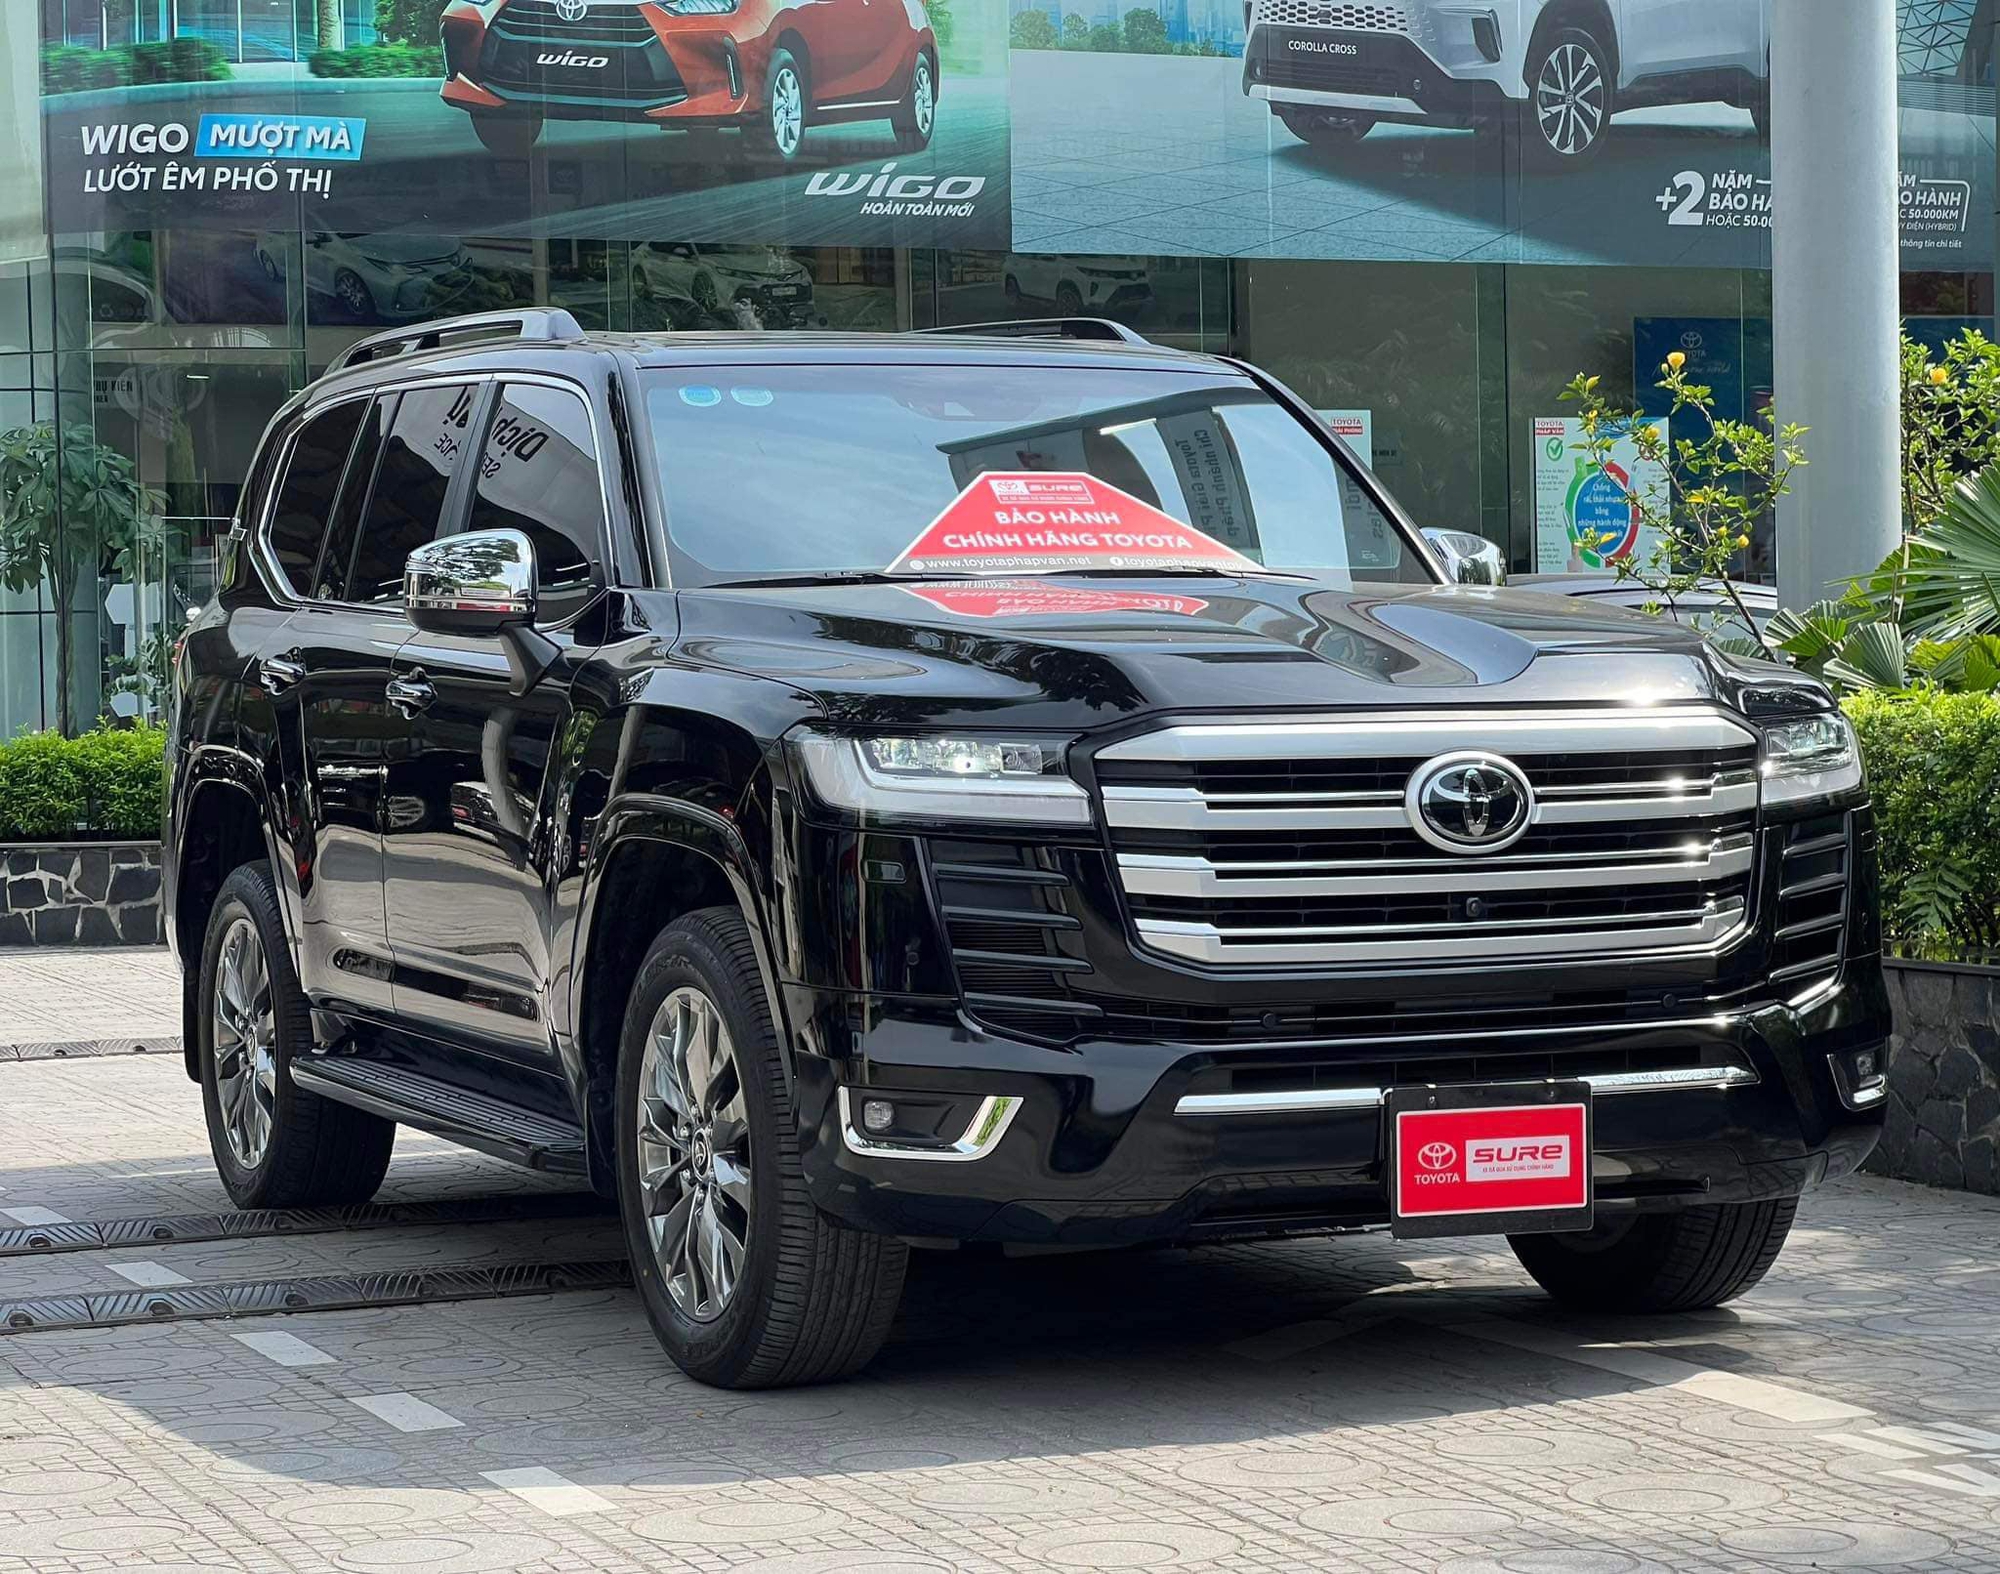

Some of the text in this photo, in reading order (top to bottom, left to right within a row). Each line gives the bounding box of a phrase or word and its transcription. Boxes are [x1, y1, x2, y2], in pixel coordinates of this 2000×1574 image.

[1288, 40, 1357, 55] COROLLA CROSS
[81, 123, 189, 155] WIGO
[209, 121, 351, 155] MƯỢT MÀ
[84, 160, 332, 200] LƯỚT ÊM PHỐ THỊ
[1712, 169, 1753, 189] NĂM
[1708, 188, 1749, 210] BẢO
[1915, 187, 1961, 206] HÀNH
[860, 201, 976, 217] HOÀN TOÀN MỚI
[1908, 208, 1959, 220] 50.000KM
[1706, 212, 1741, 229] HOẶC
[1900, 239, 1923, 250] thông
[1924, 239, 1935, 249] tin
[1949, 239, 1962, 249] tiết
[1332, 418, 1362, 426] TOYOTA
[994, 507, 1120, 525] BẢO HÀNH
[943, 529, 1193, 549] CHÍNH HÃNG TOYOTA
[926, 555, 1092, 569] www.toyotaphapvan.net
[1472, 1144, 1563, 1164] SURE
[1414, 1172, 1460, 1185] TOYOTA
